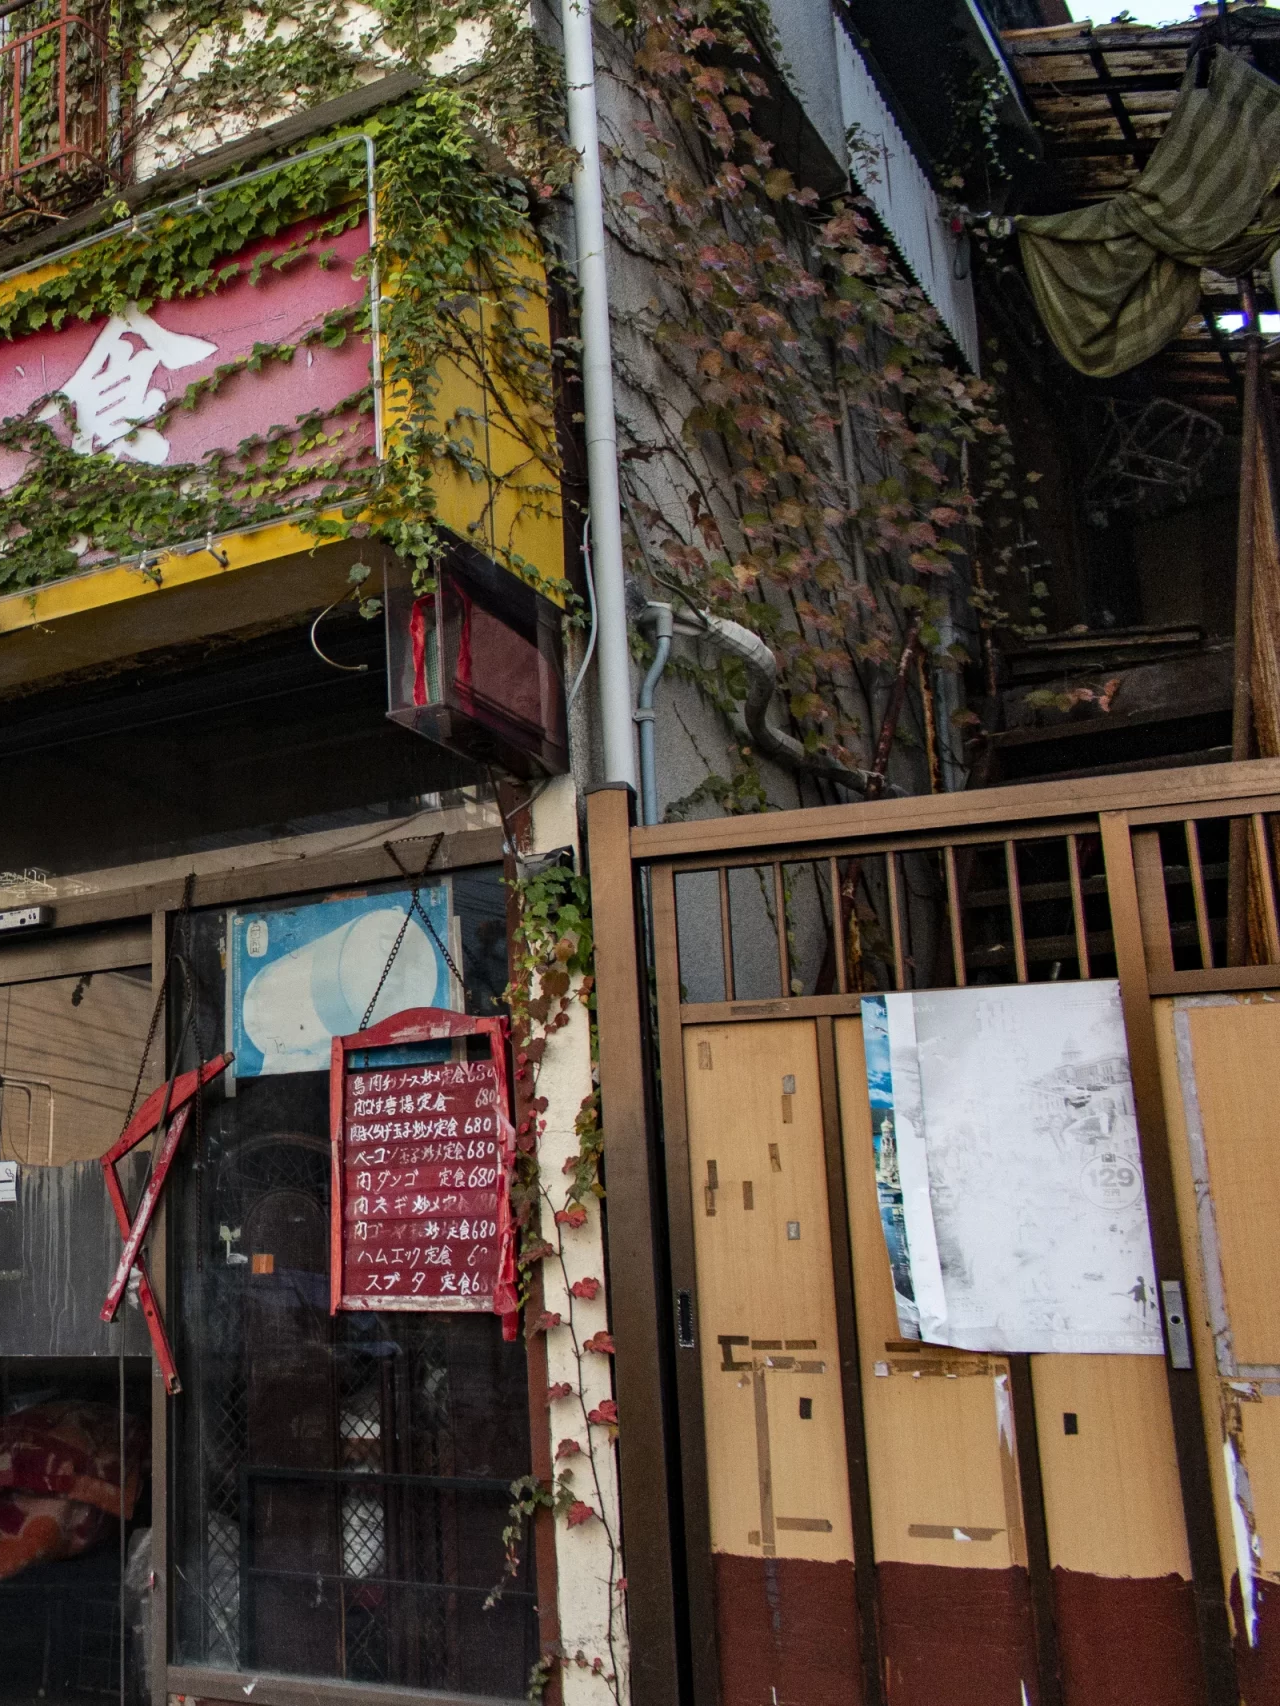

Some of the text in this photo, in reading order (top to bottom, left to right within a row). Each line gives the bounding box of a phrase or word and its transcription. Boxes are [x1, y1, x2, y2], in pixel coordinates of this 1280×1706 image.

[475, 1087, 495, 1108] 680
[464, 1117, 491, 1135] 680
[466, 1140, 495, 1160] 680
[438, 1166, 466, 1189] 定食
[467, 1165, 496, 1188] 680
[1088, 1168, 1135, 1187] 129
[471, 1219, 496, 1240] 680
[440, 1272, 472, 1295] 定食
